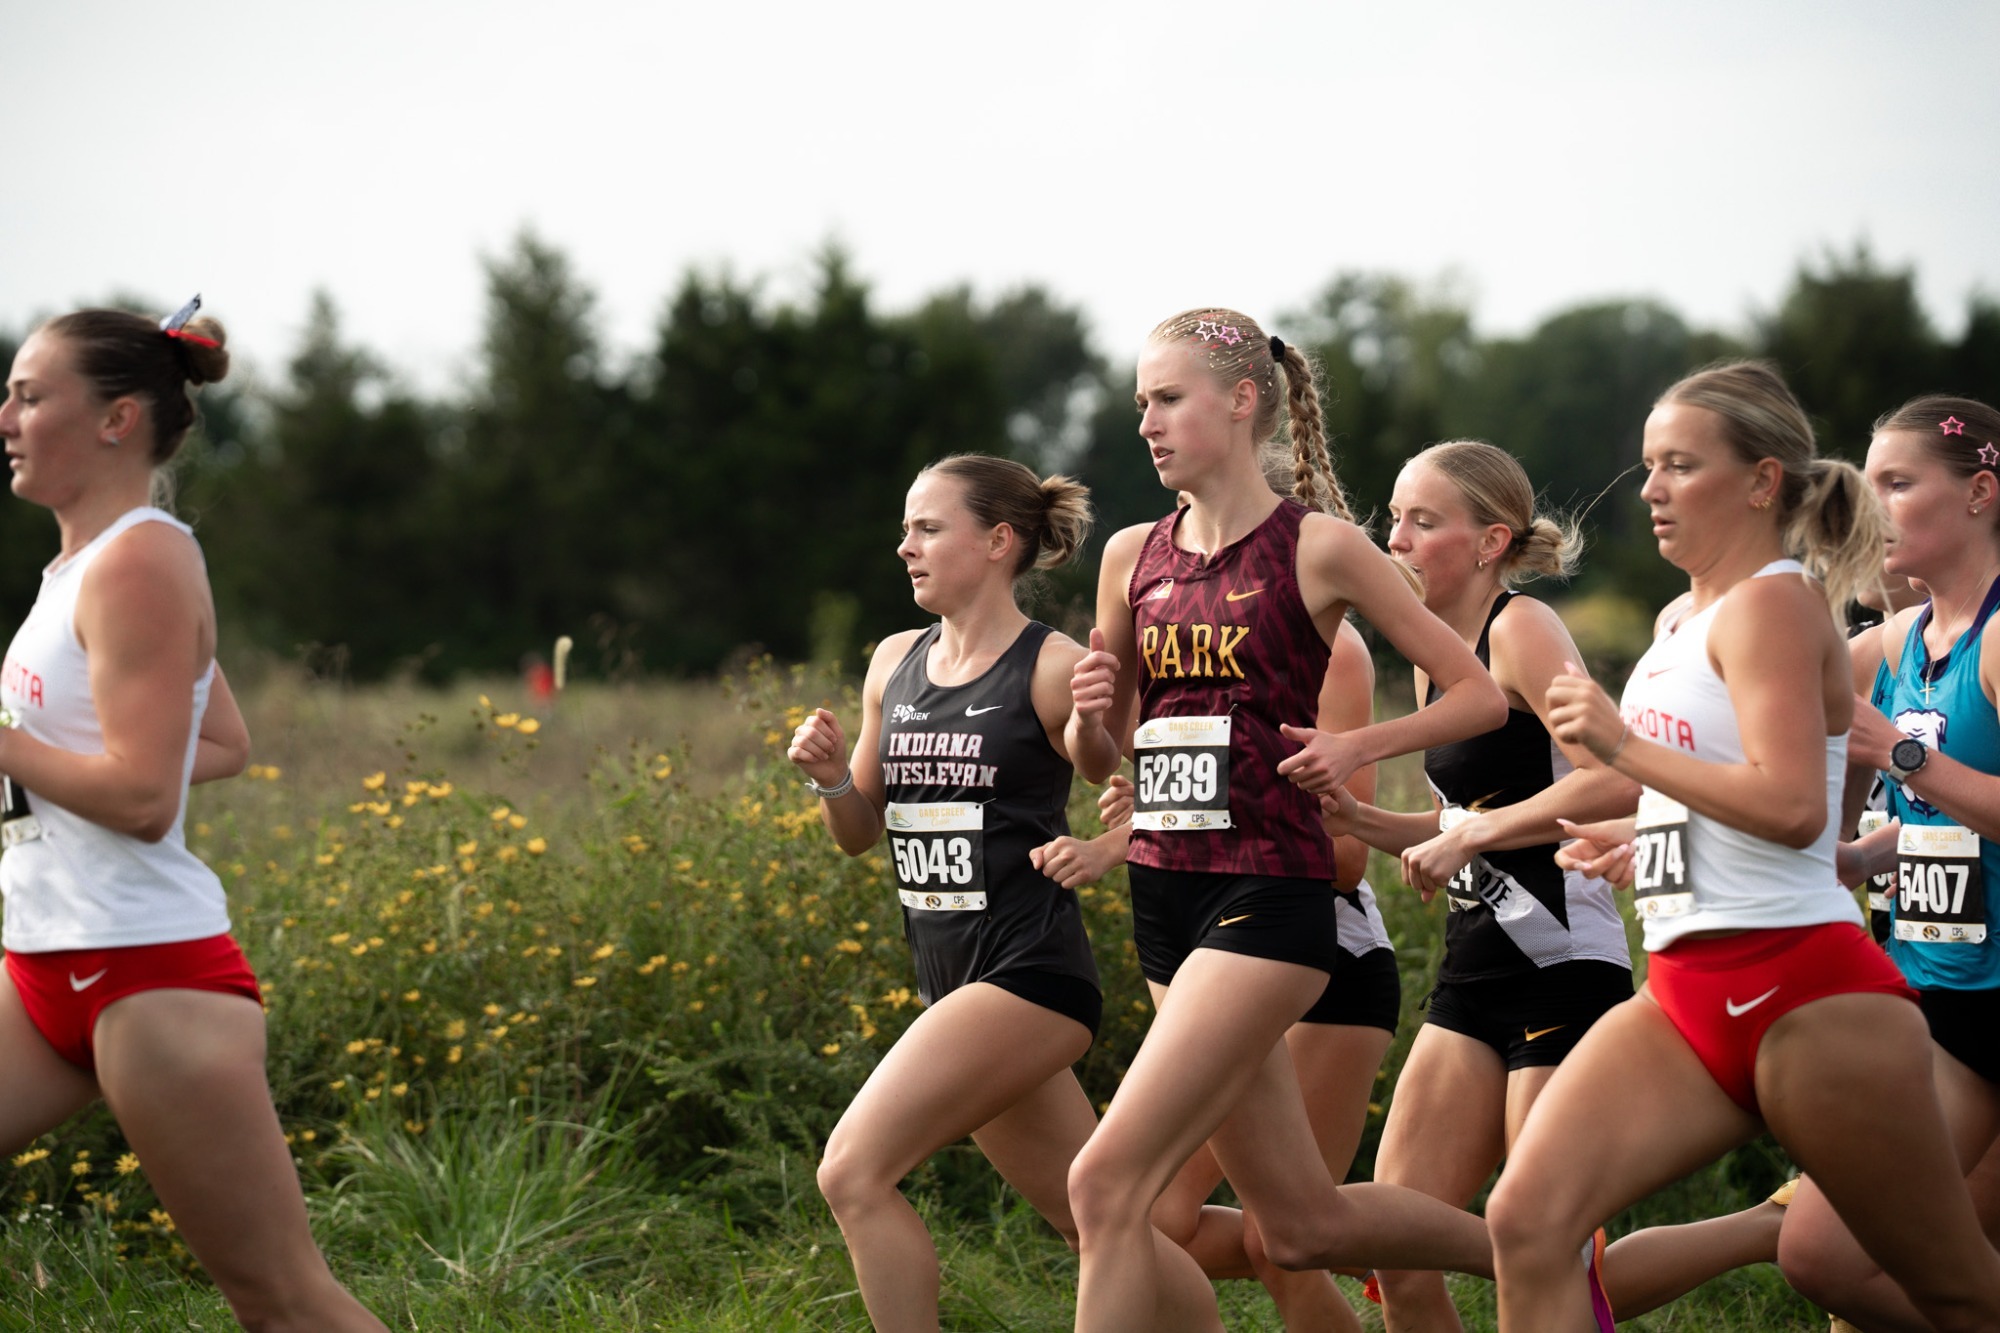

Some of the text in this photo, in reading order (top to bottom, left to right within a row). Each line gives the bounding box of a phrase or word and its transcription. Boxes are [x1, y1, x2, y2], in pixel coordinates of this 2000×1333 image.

[1143, 623, 1250, 680] PARK
[888, 732, 983, 758] INDIANA
[882, 762, 998, 788] WESLEYAN
[1139, 753, 1218, 804] 5239
[1191, 814, 1205, 823] CPS
[892, 837, 973, 885] 5043
[953, 895, 965, 904] CPS
[1479, 870, 1513, 909] ATE
[1899, 861, 1969, 914] 5407
